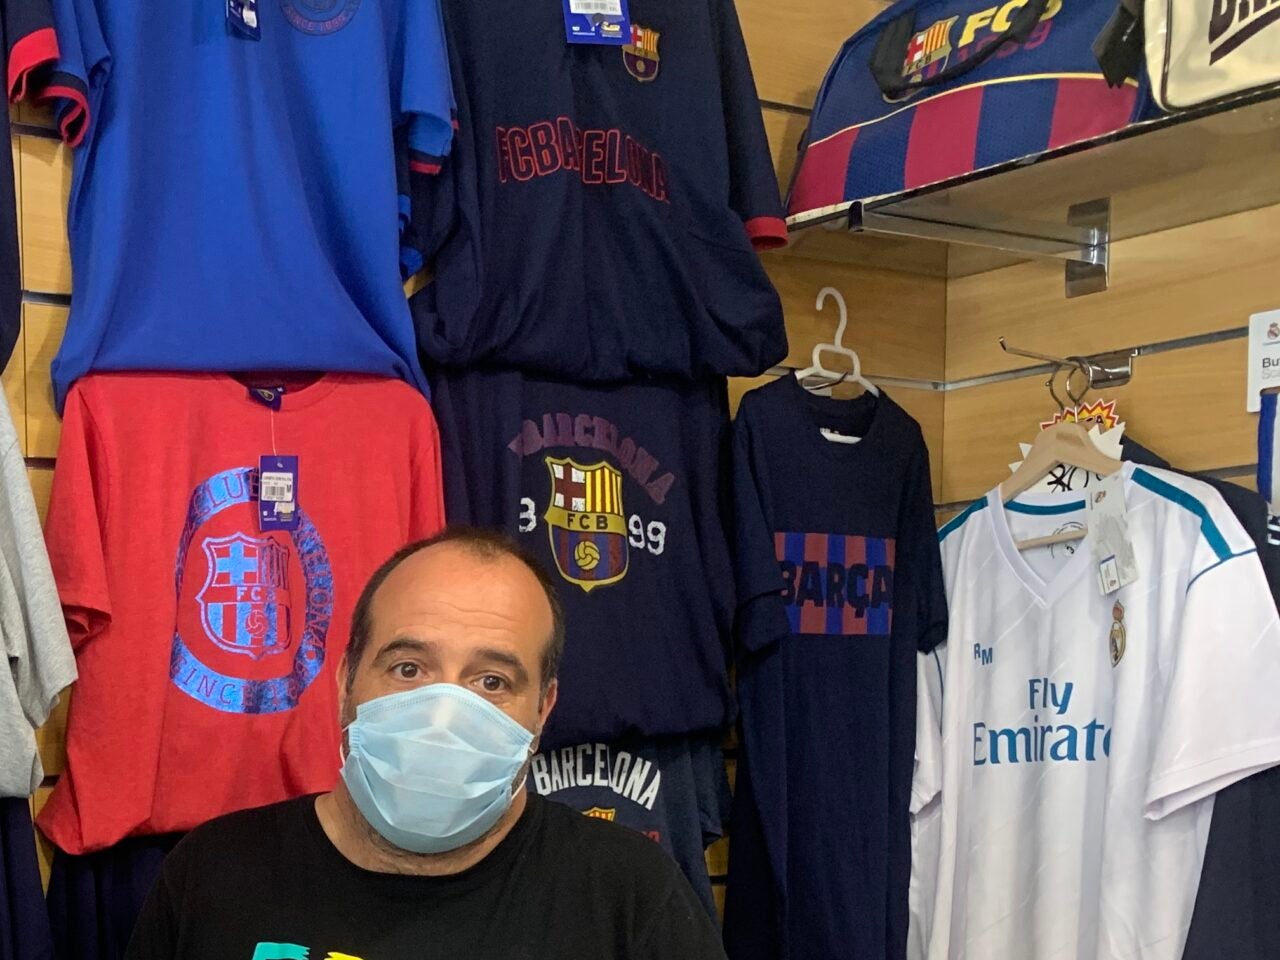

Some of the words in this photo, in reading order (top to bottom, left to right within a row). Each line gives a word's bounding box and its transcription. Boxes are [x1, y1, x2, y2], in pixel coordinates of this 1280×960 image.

[567, 513, 608, 531] FCB
[628, 513, 667, 556] 99
[780, 561, 894, 619] BARÇA
[973, 642, 993, 666] RM
[1028, 677, 1074, 715] Fly
[531, 742, 661, 811] BARCELONA
